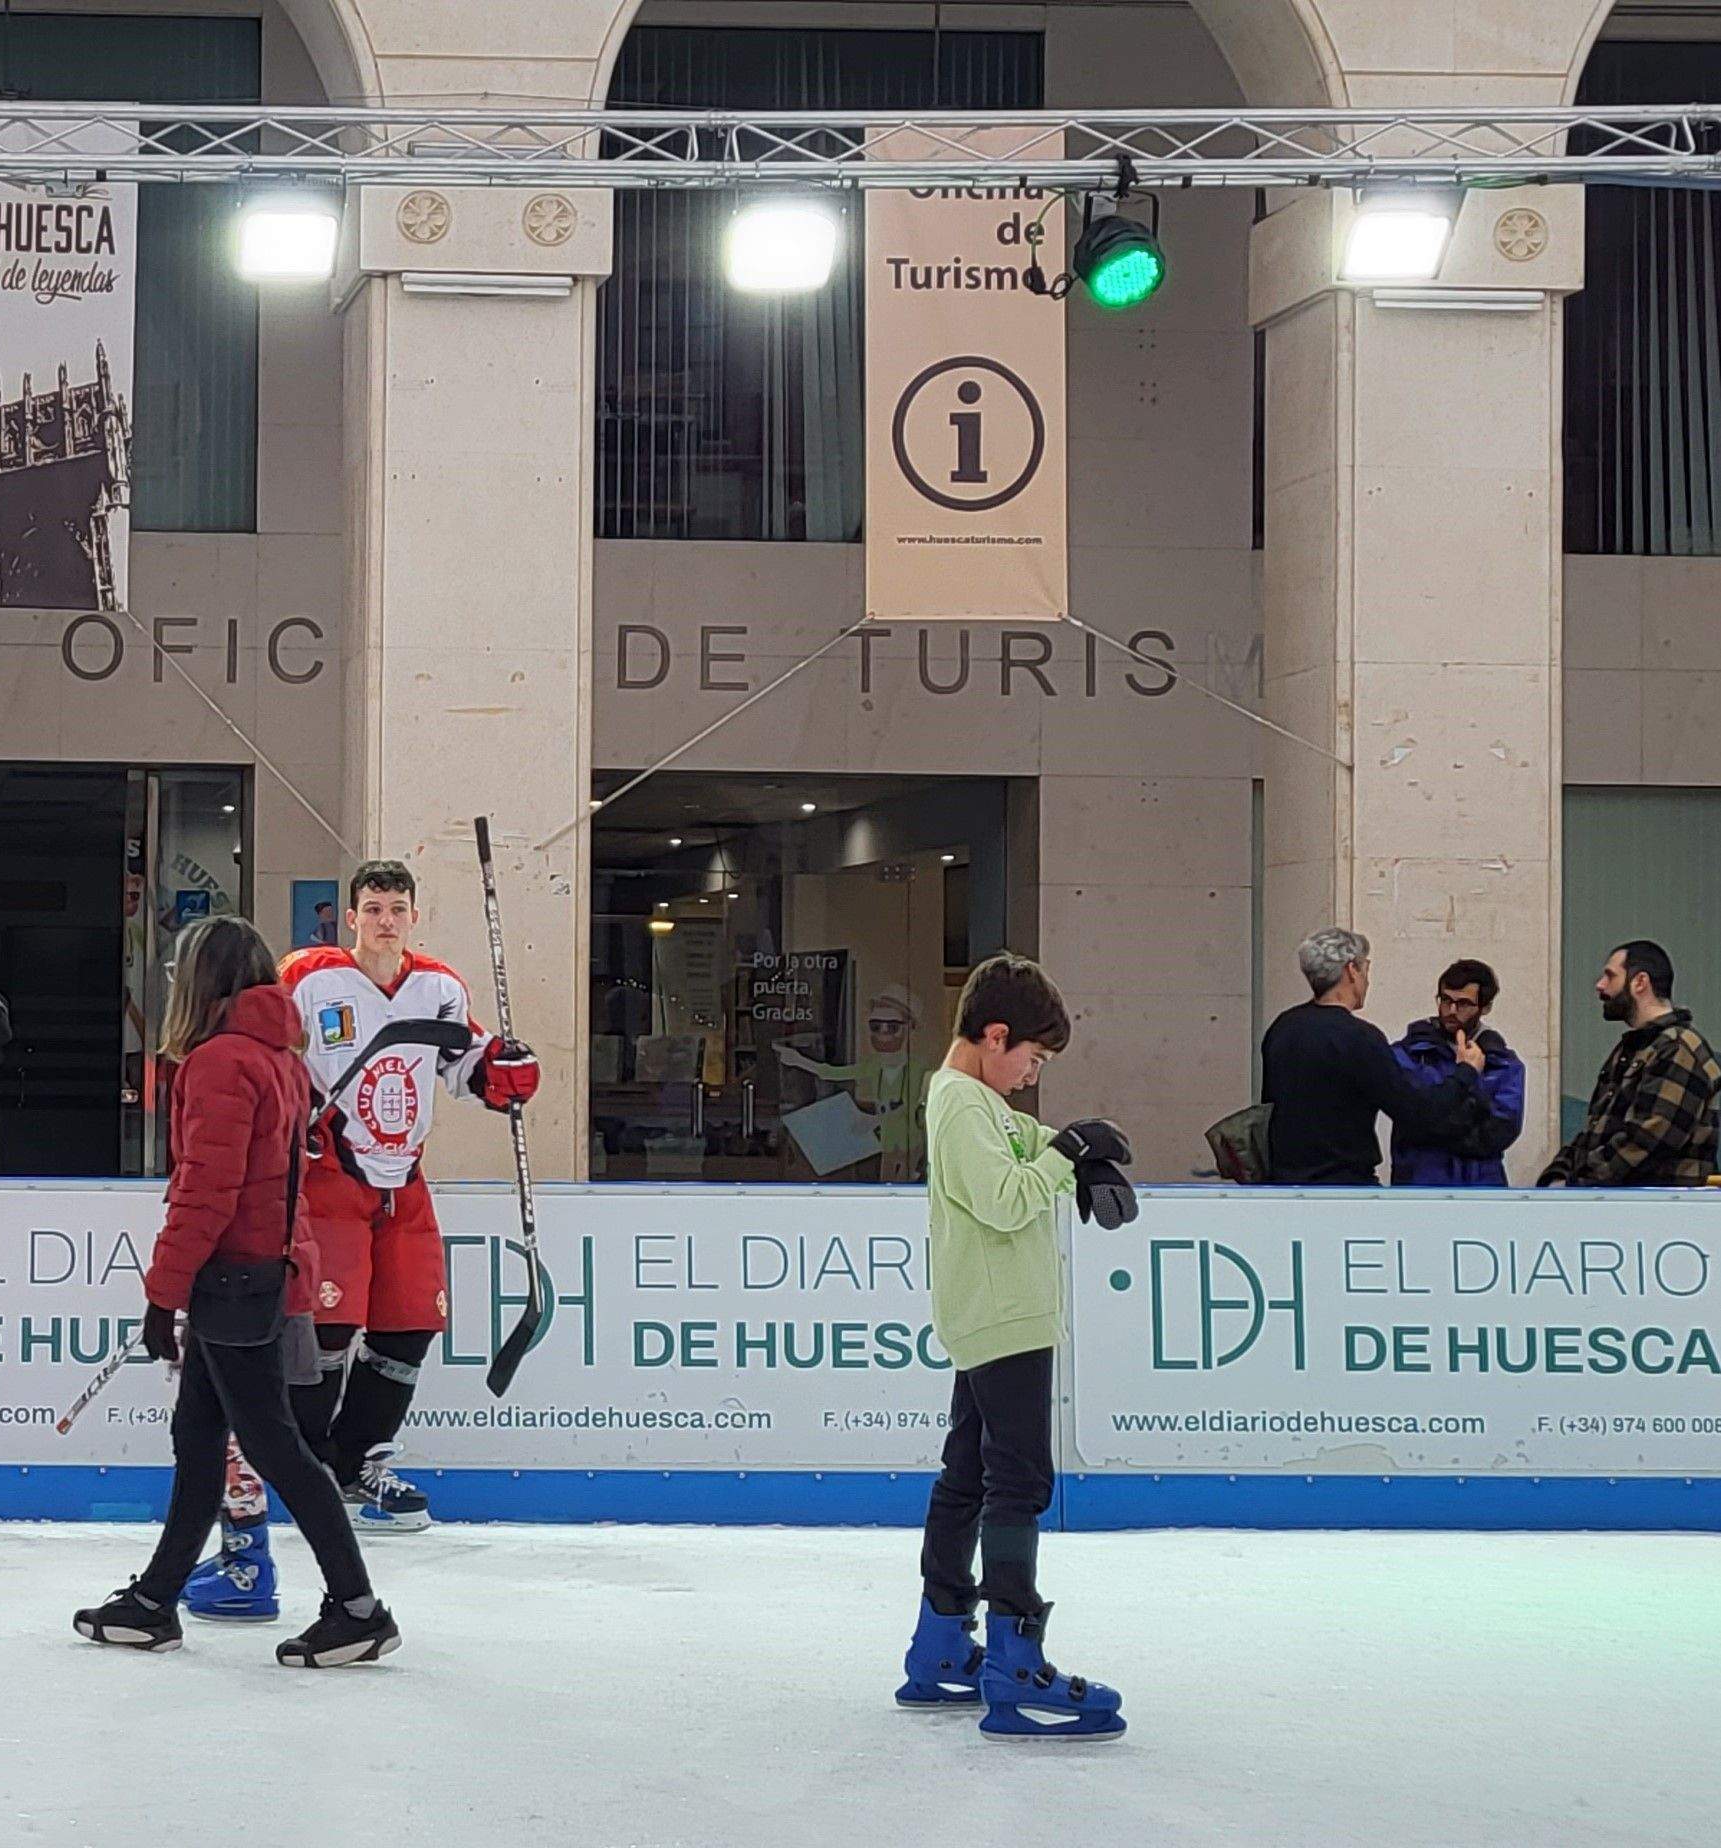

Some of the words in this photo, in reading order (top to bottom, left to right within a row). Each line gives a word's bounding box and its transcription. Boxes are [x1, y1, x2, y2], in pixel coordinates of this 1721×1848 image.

[996, 212, 1045, 246] de
[1, 258, 26, 291] de
[32, 258, 121, 304] leyendas
[897, 535, 1043, 545] www.huescaturismo.com
[62, 614, 324, 684] OFIC
[617, 625, 749, 690] DE
[841, 628, 1264, 697] TURISM
[753, 951, 781, 969] Por
[786, 952, 799, 969] la
[804, 954, 838, 970] otra
[753, 1003, 813, 1022] Gracias
[29, 1229, 146, 1286] DIA
[633, 1235, 719, 1290] EL
[742, 1236, 931, 1291] DIARI
[1345, 1240, 1431, 1294] EL
[1453, 1240, 1709, 1296] DIARIO
[22, 1316, 155, 1364] HUE
[633, 1321, 719, 1367] DE
[736, 1322, 954, 1370] HUESC
[1345, 1326, 1432, 1372] DE
[1448, 1326, 1721, 1375] HUESCA
[107, 1407, 122, 1424] F.
[402, 1404, 772, 1430] www.eldiariodehuesca.com
[844, 1410, 892, 1430] (+34)
[897, 1412, 930, 1428] 974
[1112, 1410, 1485, 1435] www.eldiariodehuesca.com
[1559, 1416, 1607, 1436] (+34)
[1612, 1417, 1646, 1433] 974
[1652, 1418, 1686, 1433] 600
